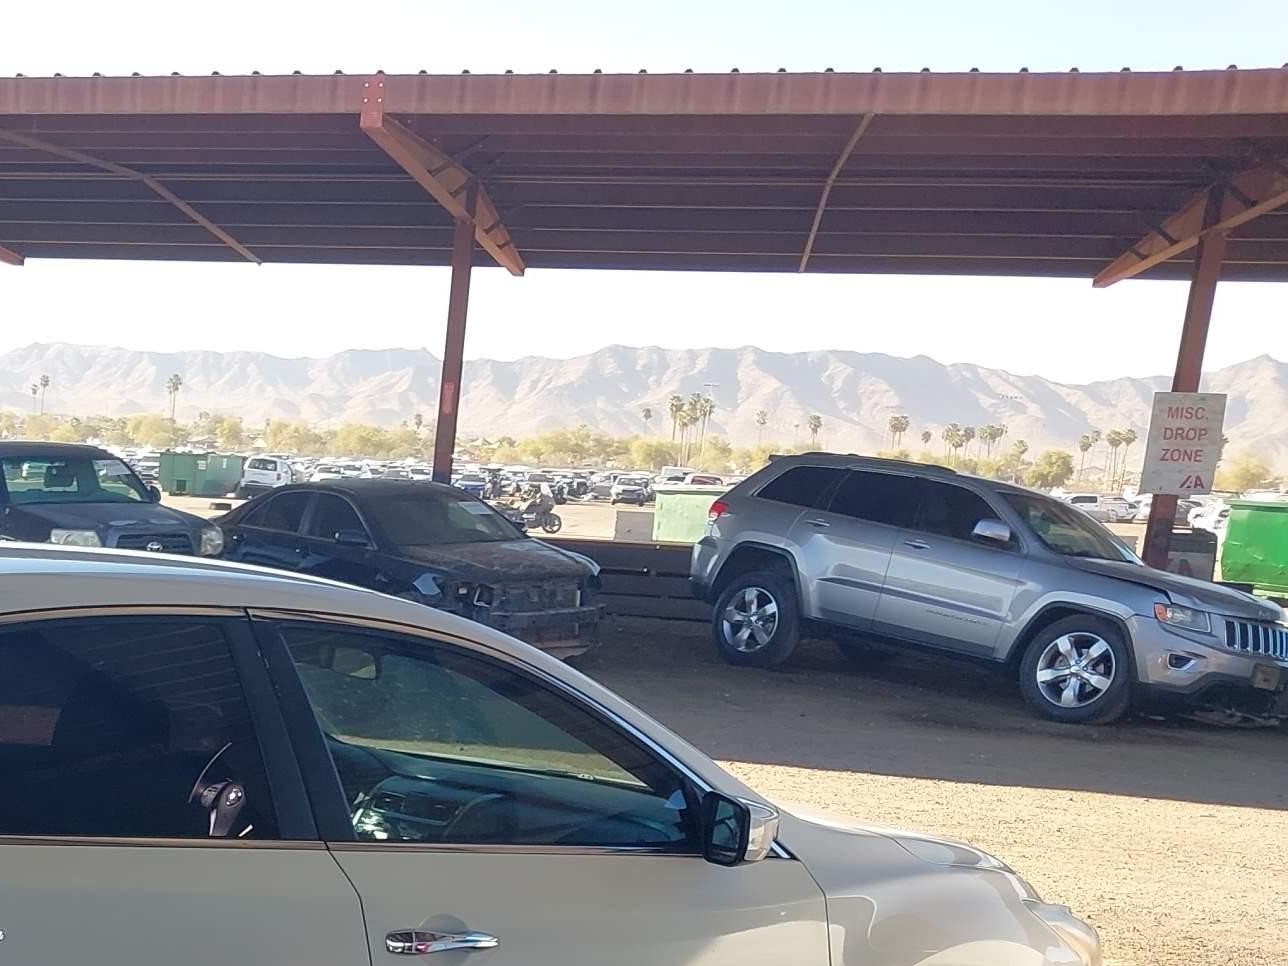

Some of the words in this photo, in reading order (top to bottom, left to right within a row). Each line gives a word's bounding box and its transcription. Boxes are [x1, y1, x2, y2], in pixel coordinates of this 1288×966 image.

[1167, 406, 1209, 421] MISC.
[1163, 427, 1209, 441] DROP
[1160, 448, 1204, 463] ZONE
